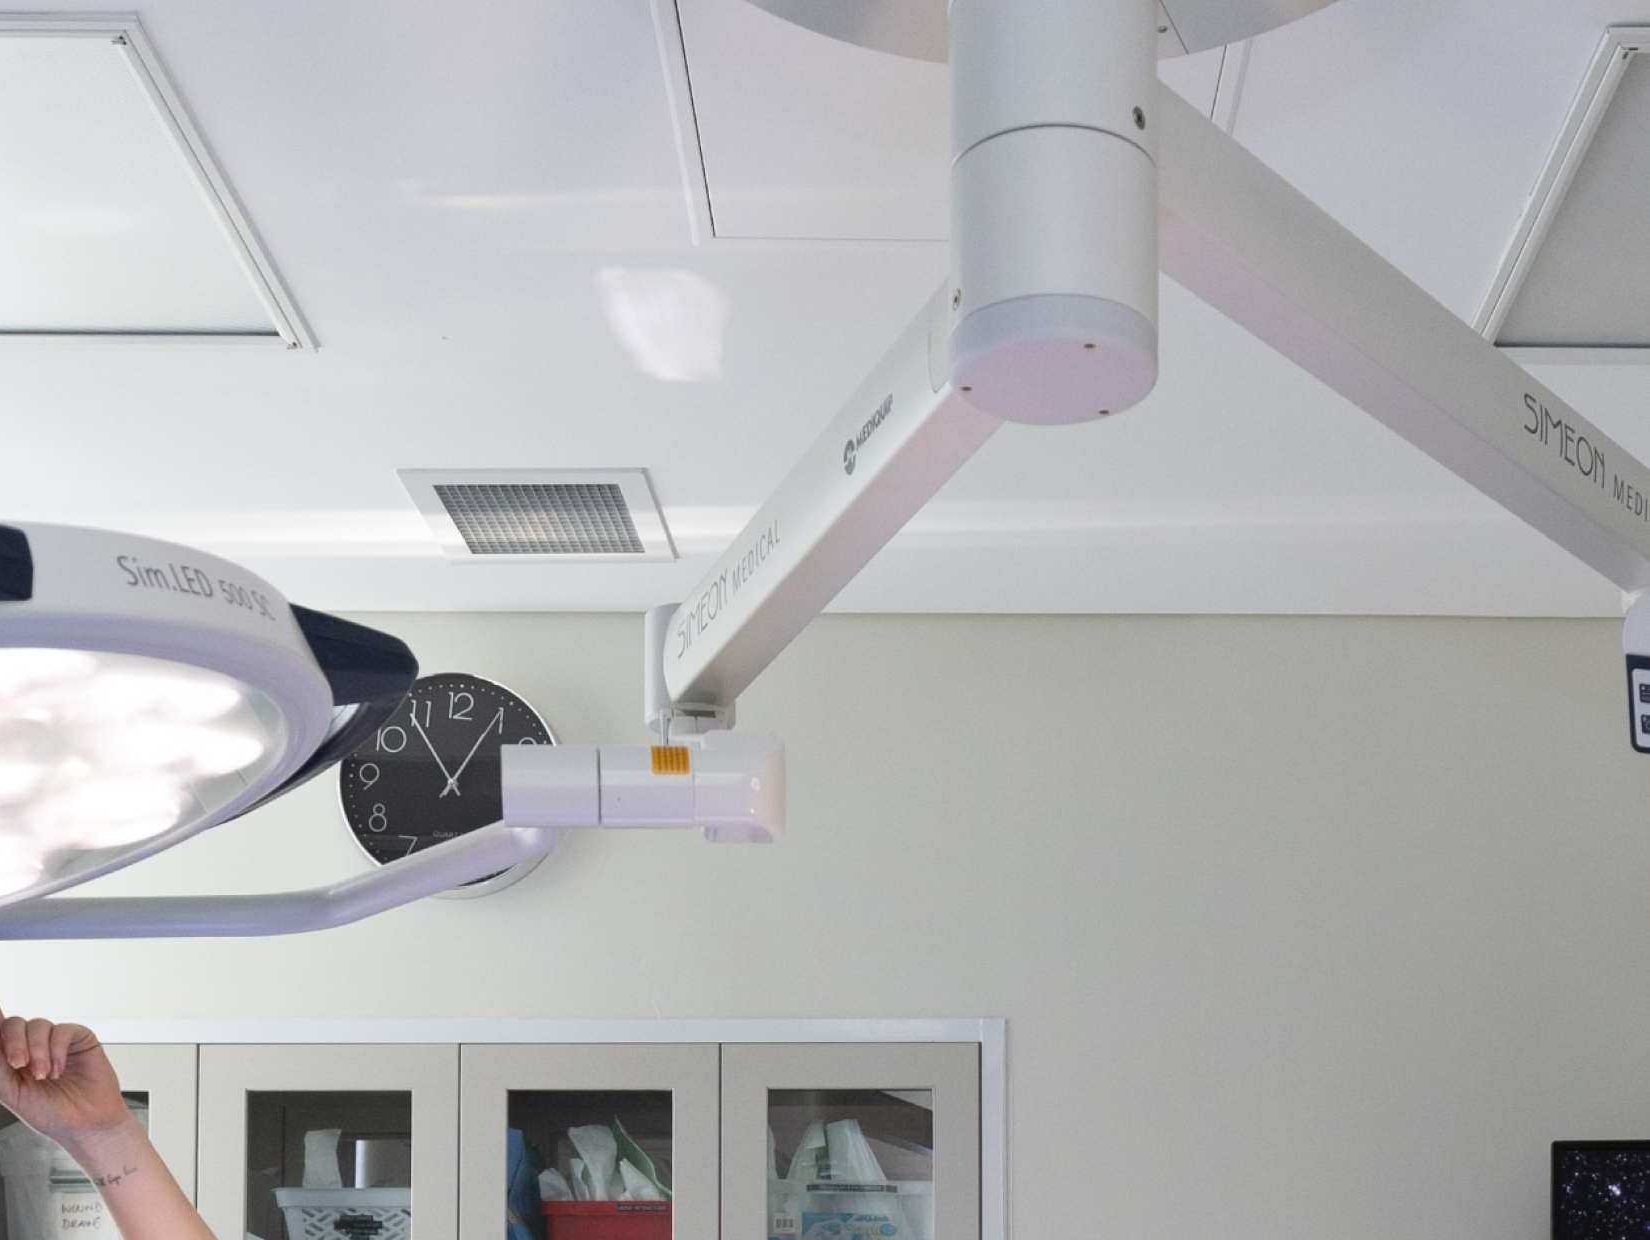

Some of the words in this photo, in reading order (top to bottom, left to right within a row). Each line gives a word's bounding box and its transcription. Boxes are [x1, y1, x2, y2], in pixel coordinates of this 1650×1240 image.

[855, 393, 894, 451] MEDIQUIP
[1524, 393, 1605, 489] SIMEON
[116, 554, 214, 598] Sim.LED
[677, 567, 728, 660] SIMEON
[732, 518, 781, 595] MEDICAL
[410, 699, 432, 729] 11
[448, 691, 475, 722] 12
[498, 706, 505, 735] 1
[376, 725, 407, 753] 10
[359, 762, 380, 791] 9
[368, 802, 388, 833] 8
[398, 835, 419, 856] 7
